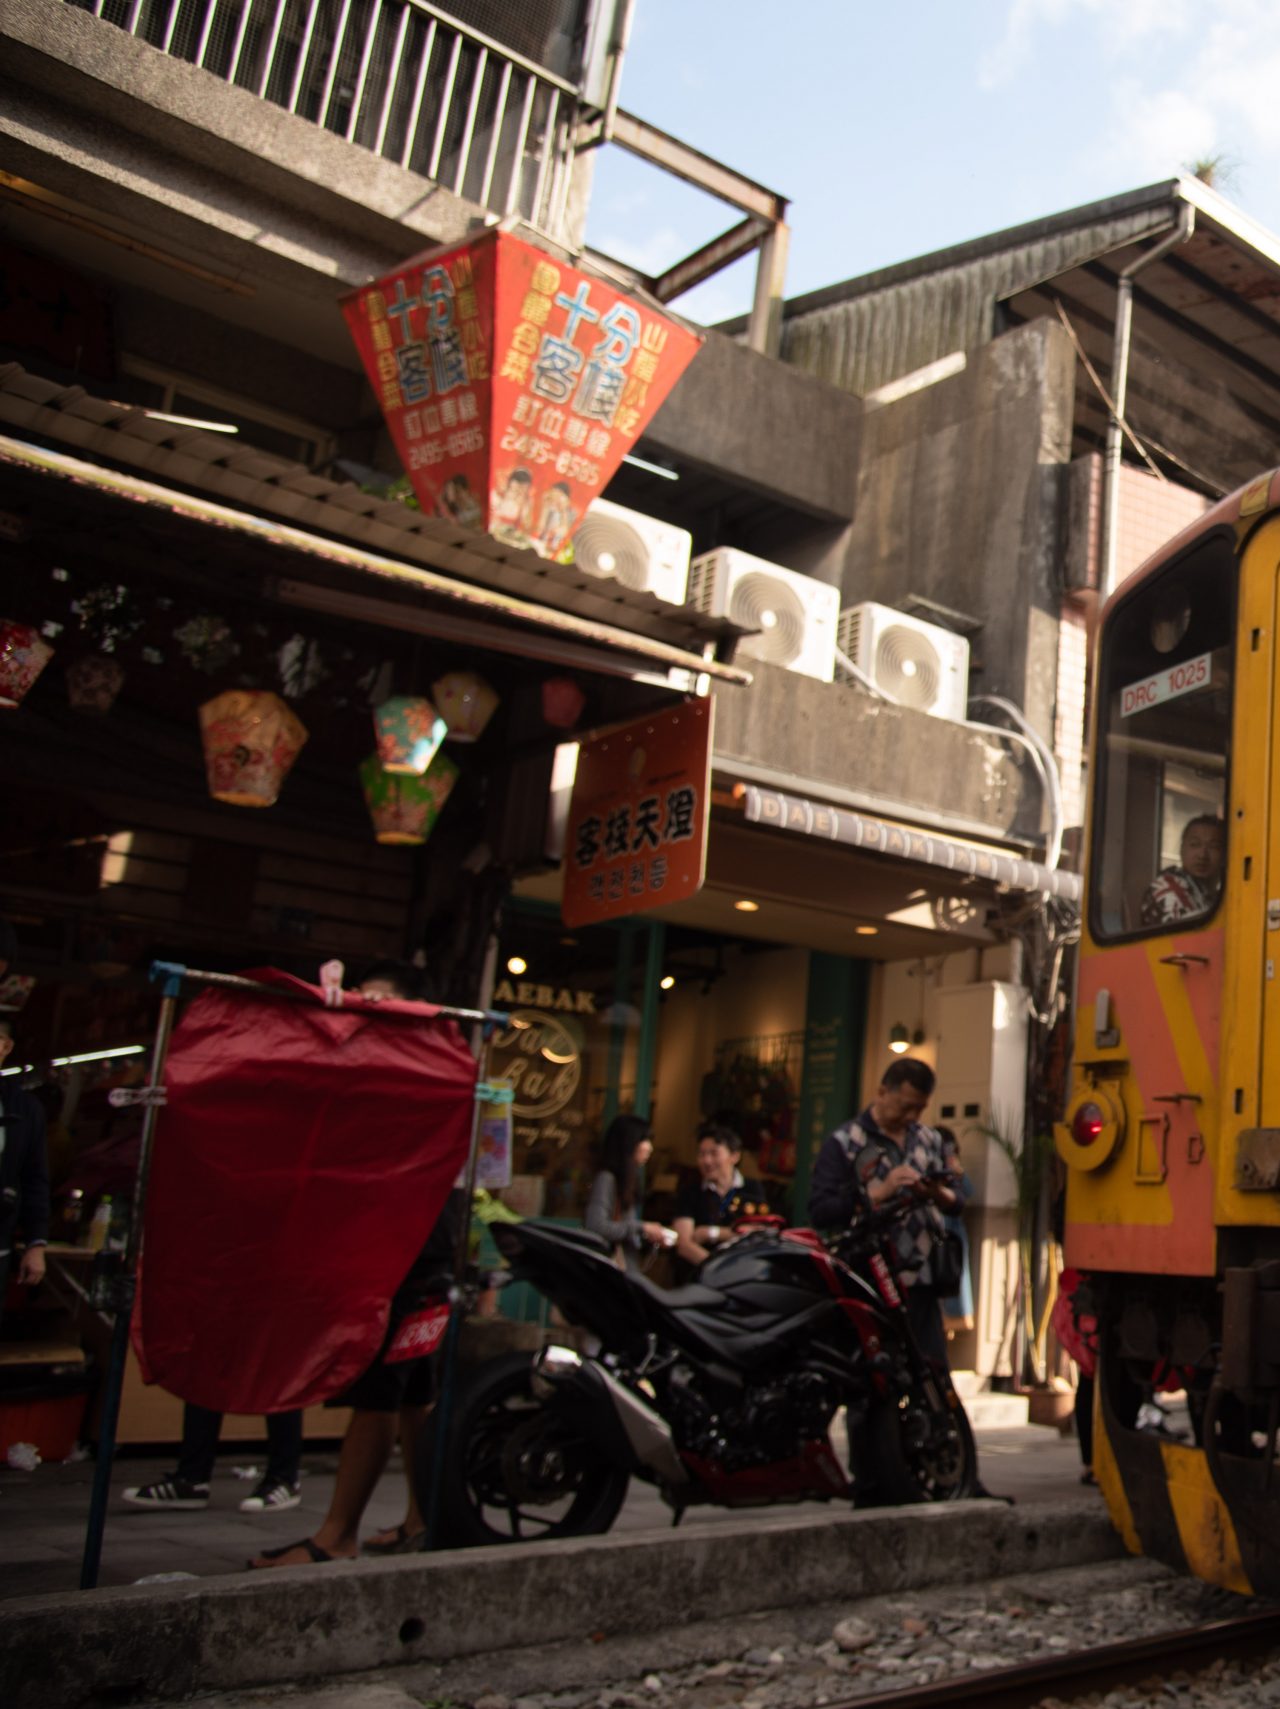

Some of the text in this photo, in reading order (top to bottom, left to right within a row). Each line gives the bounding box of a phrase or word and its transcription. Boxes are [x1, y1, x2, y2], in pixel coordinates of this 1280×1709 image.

[387, 264, 454, 345] 十分
[555, 280, 641, 367] 十分
[1124, 660, 1206, 712] DRC 1025
[763, 797, 830, 831] DAE
[494, 980, 596, 1013] AEBAK
